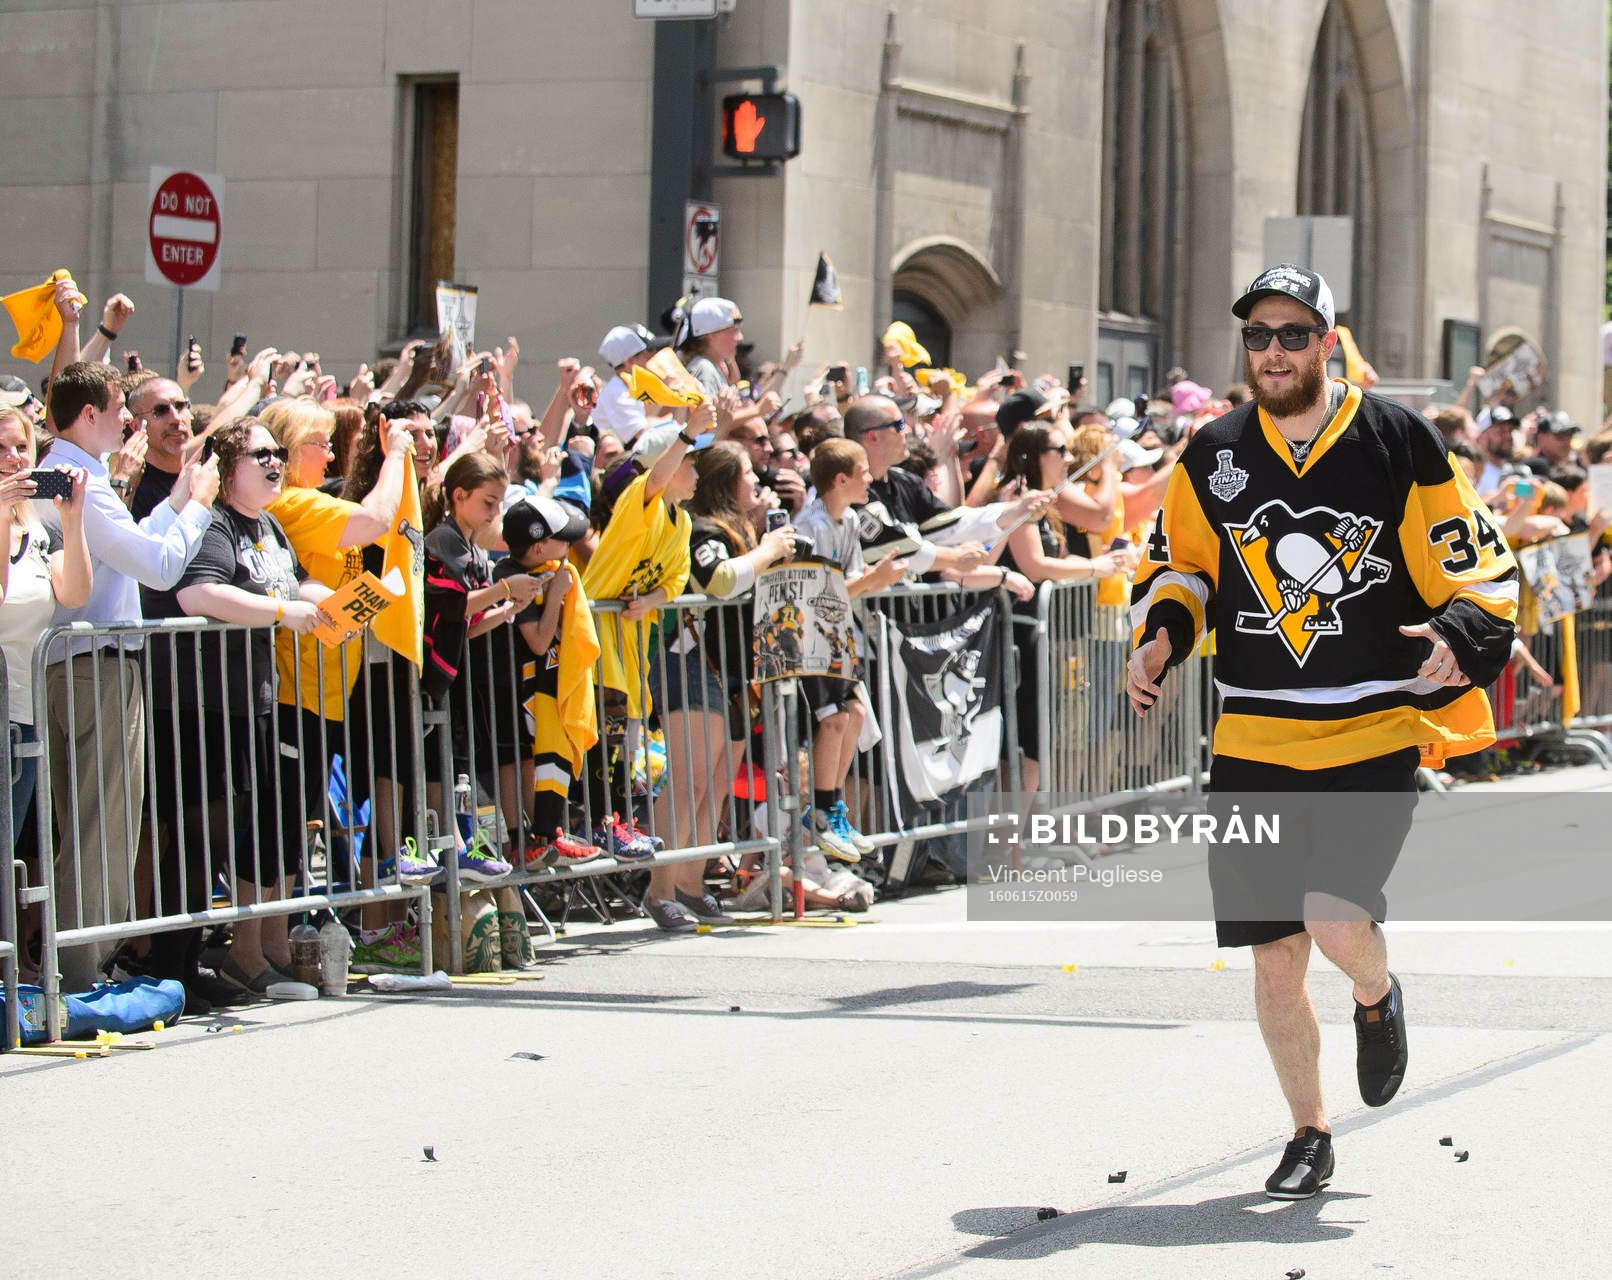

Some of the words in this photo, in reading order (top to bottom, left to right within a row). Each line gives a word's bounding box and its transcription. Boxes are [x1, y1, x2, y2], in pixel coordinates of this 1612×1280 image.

[161, 191, 178, 211] DO
[185, 194, 211, 215] NOT
[162, 243, 204, 265] ENTER
[1212, 472, 1244, 486] FINAL
[1428, 509, 1507, 576] 34
[353, 581, 391, 611] THAN
